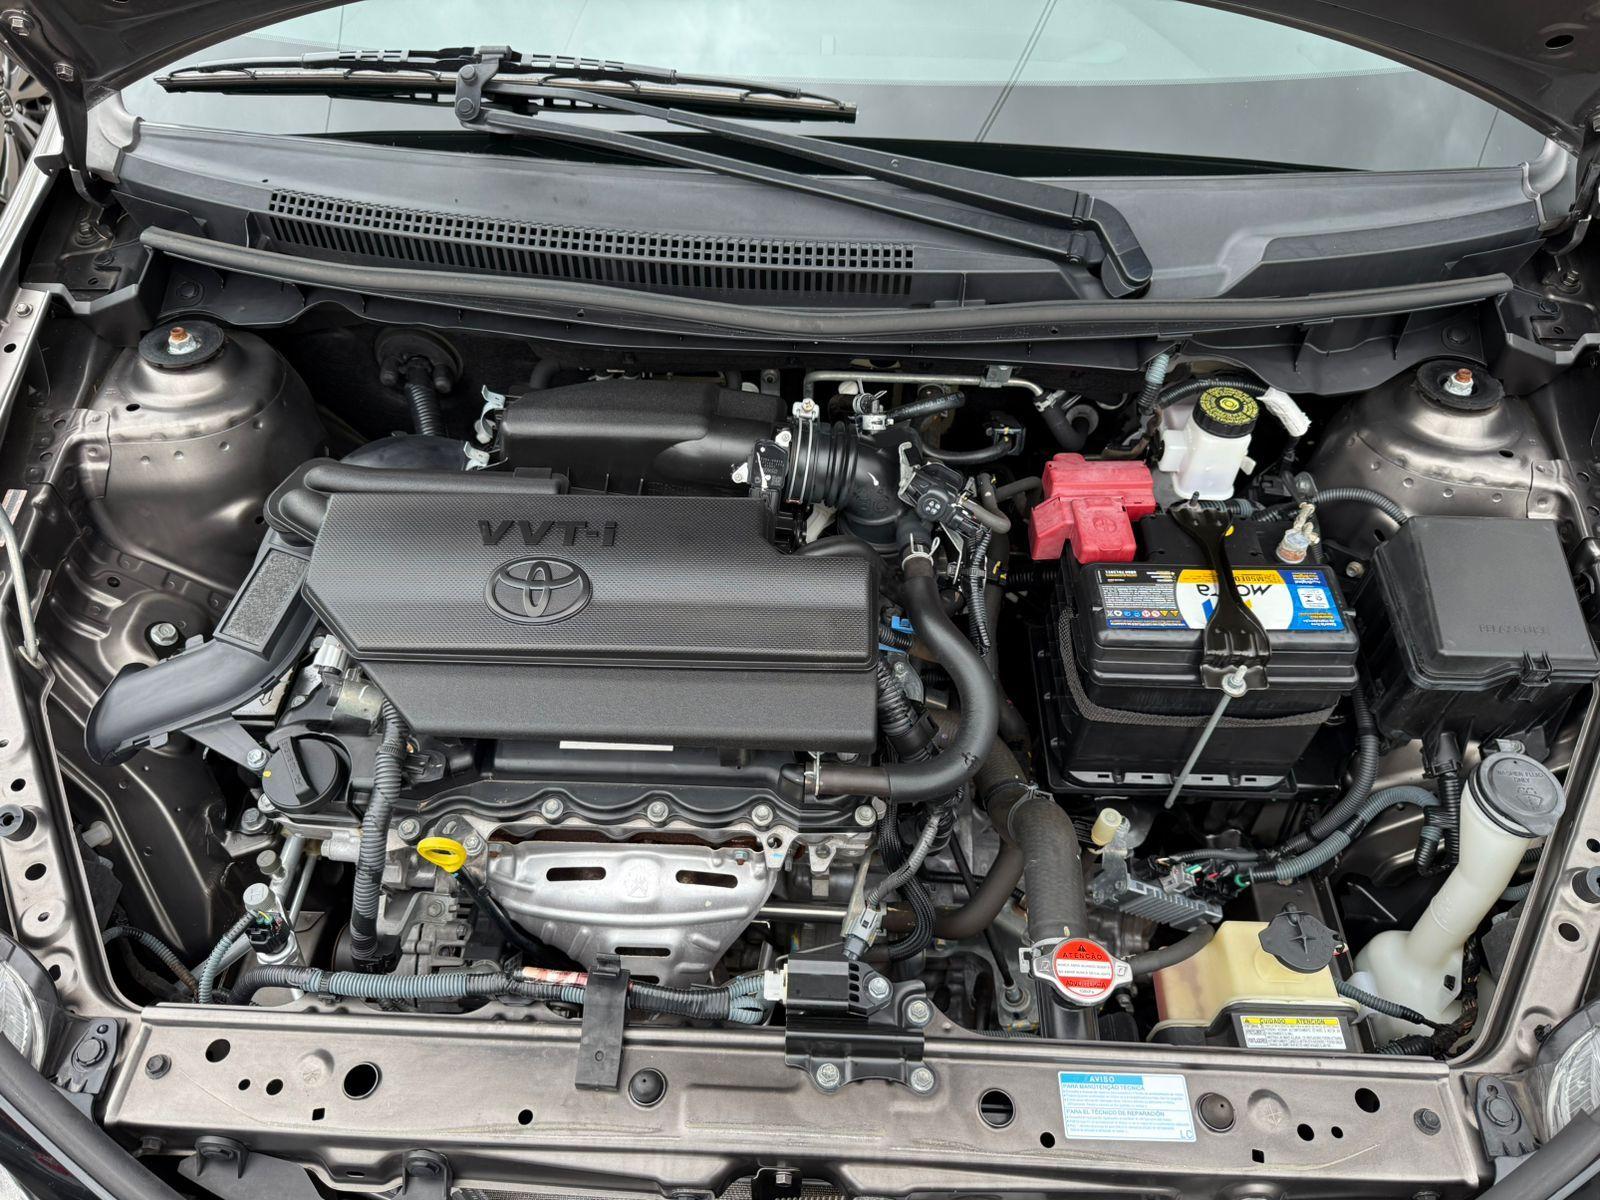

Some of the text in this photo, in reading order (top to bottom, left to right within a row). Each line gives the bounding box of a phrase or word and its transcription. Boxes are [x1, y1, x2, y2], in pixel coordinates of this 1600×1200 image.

[478, 520, 618, 546] VVT-i
[1089, 1075, 1115, 1083] AVISO
[1180, 1130, 1194, 1139] LC
